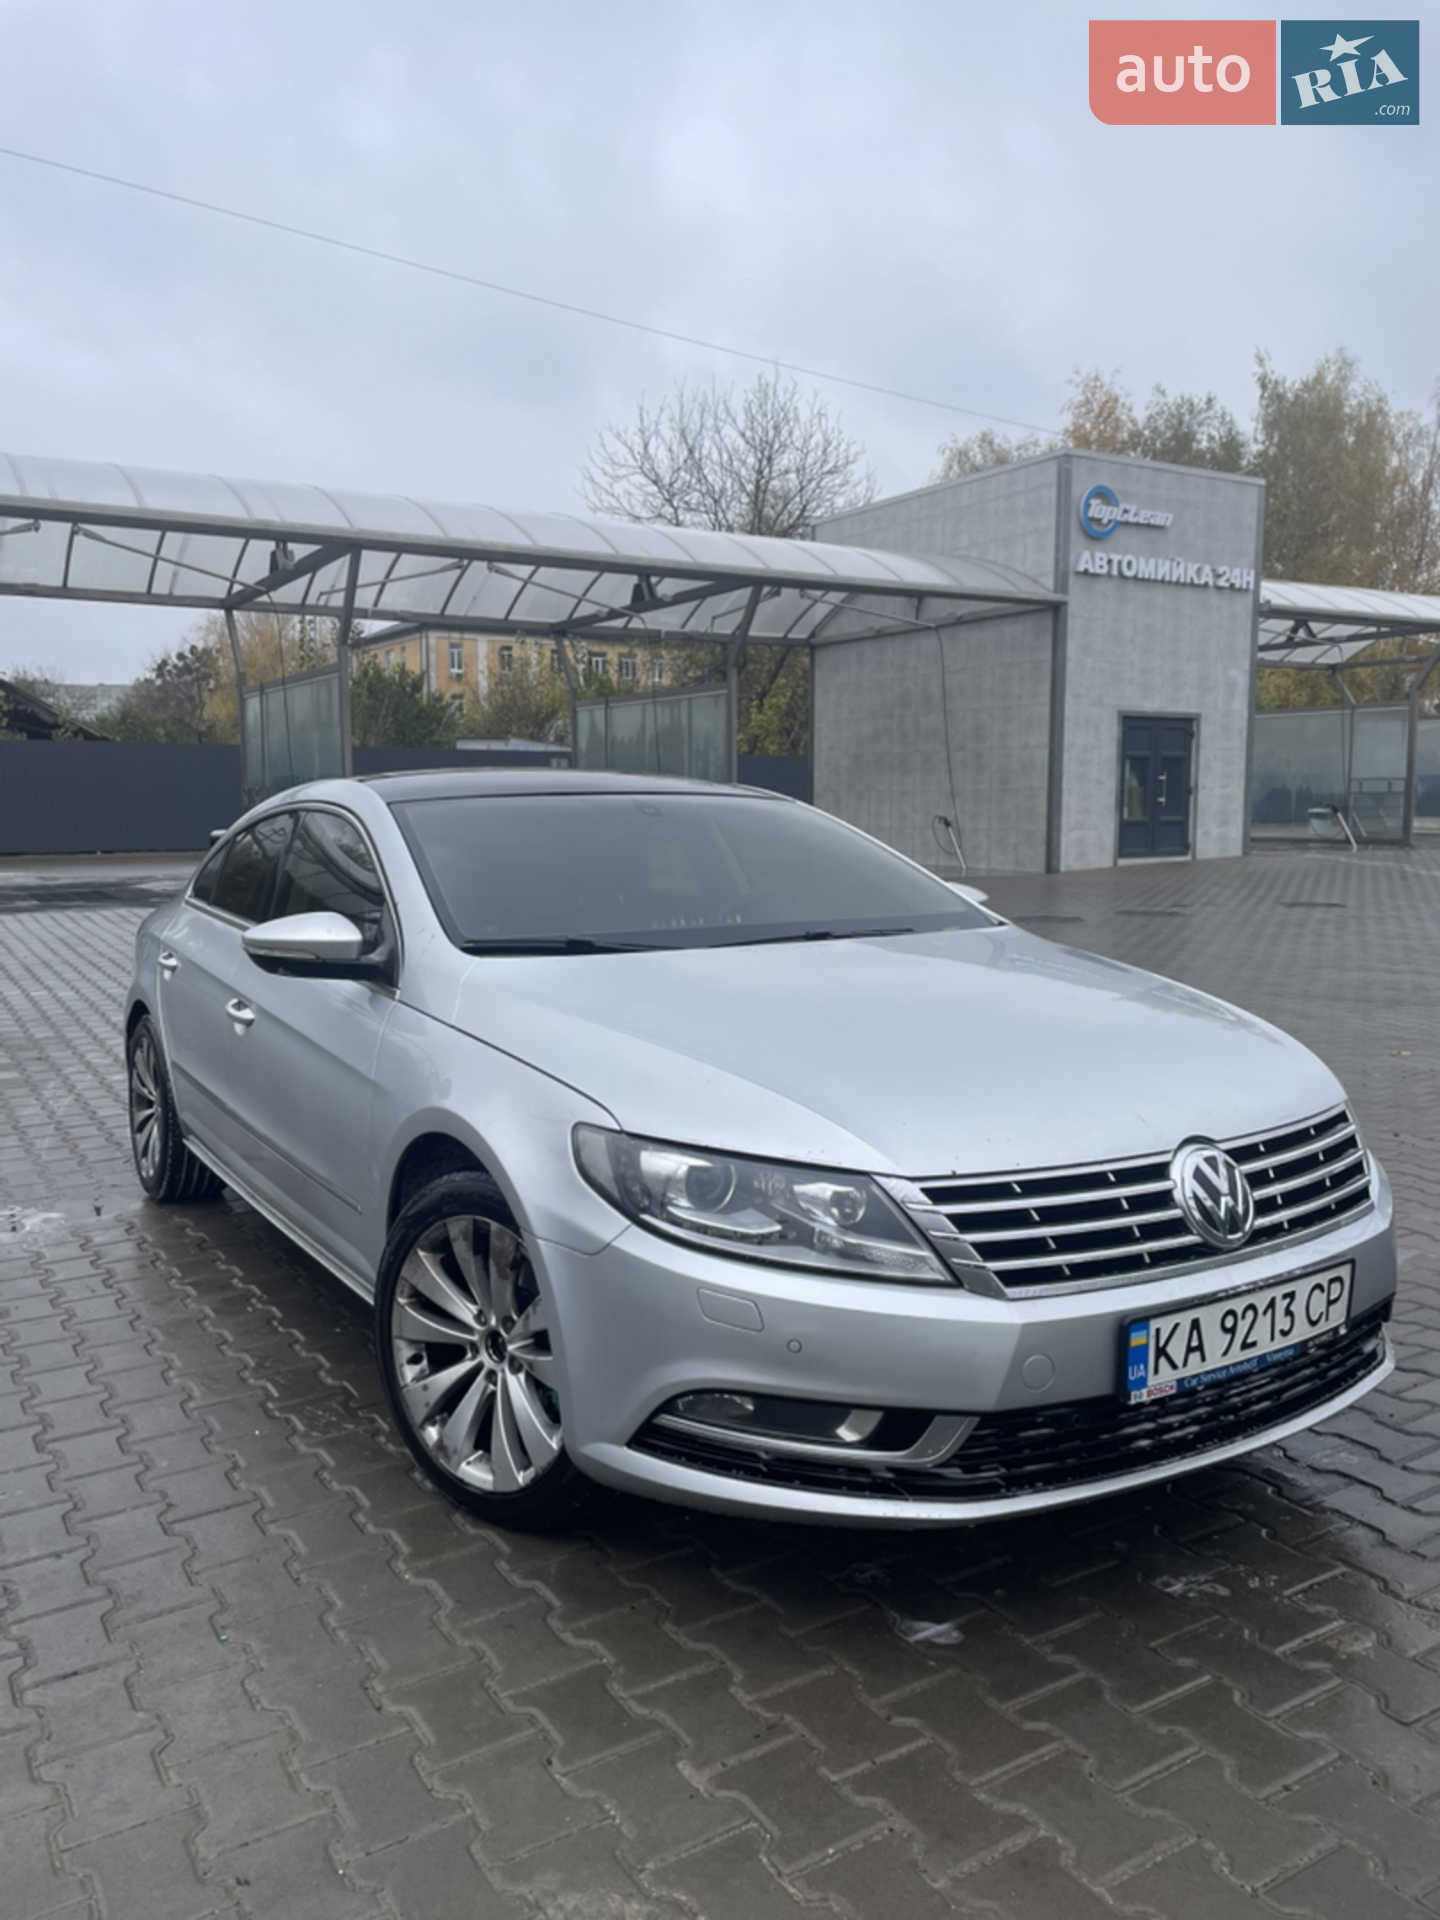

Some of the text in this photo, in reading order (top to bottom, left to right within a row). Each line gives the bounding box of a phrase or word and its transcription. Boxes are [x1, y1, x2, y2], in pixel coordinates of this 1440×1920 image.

[1076, 550, 1214, 586] АВТОМИЙКА
[1152, 1275, 1345, 1375] KA 9213 CP
[1128, 1364, 1146, 1380] UA
[1146, 1384, 1175, 1398] BOSCH
